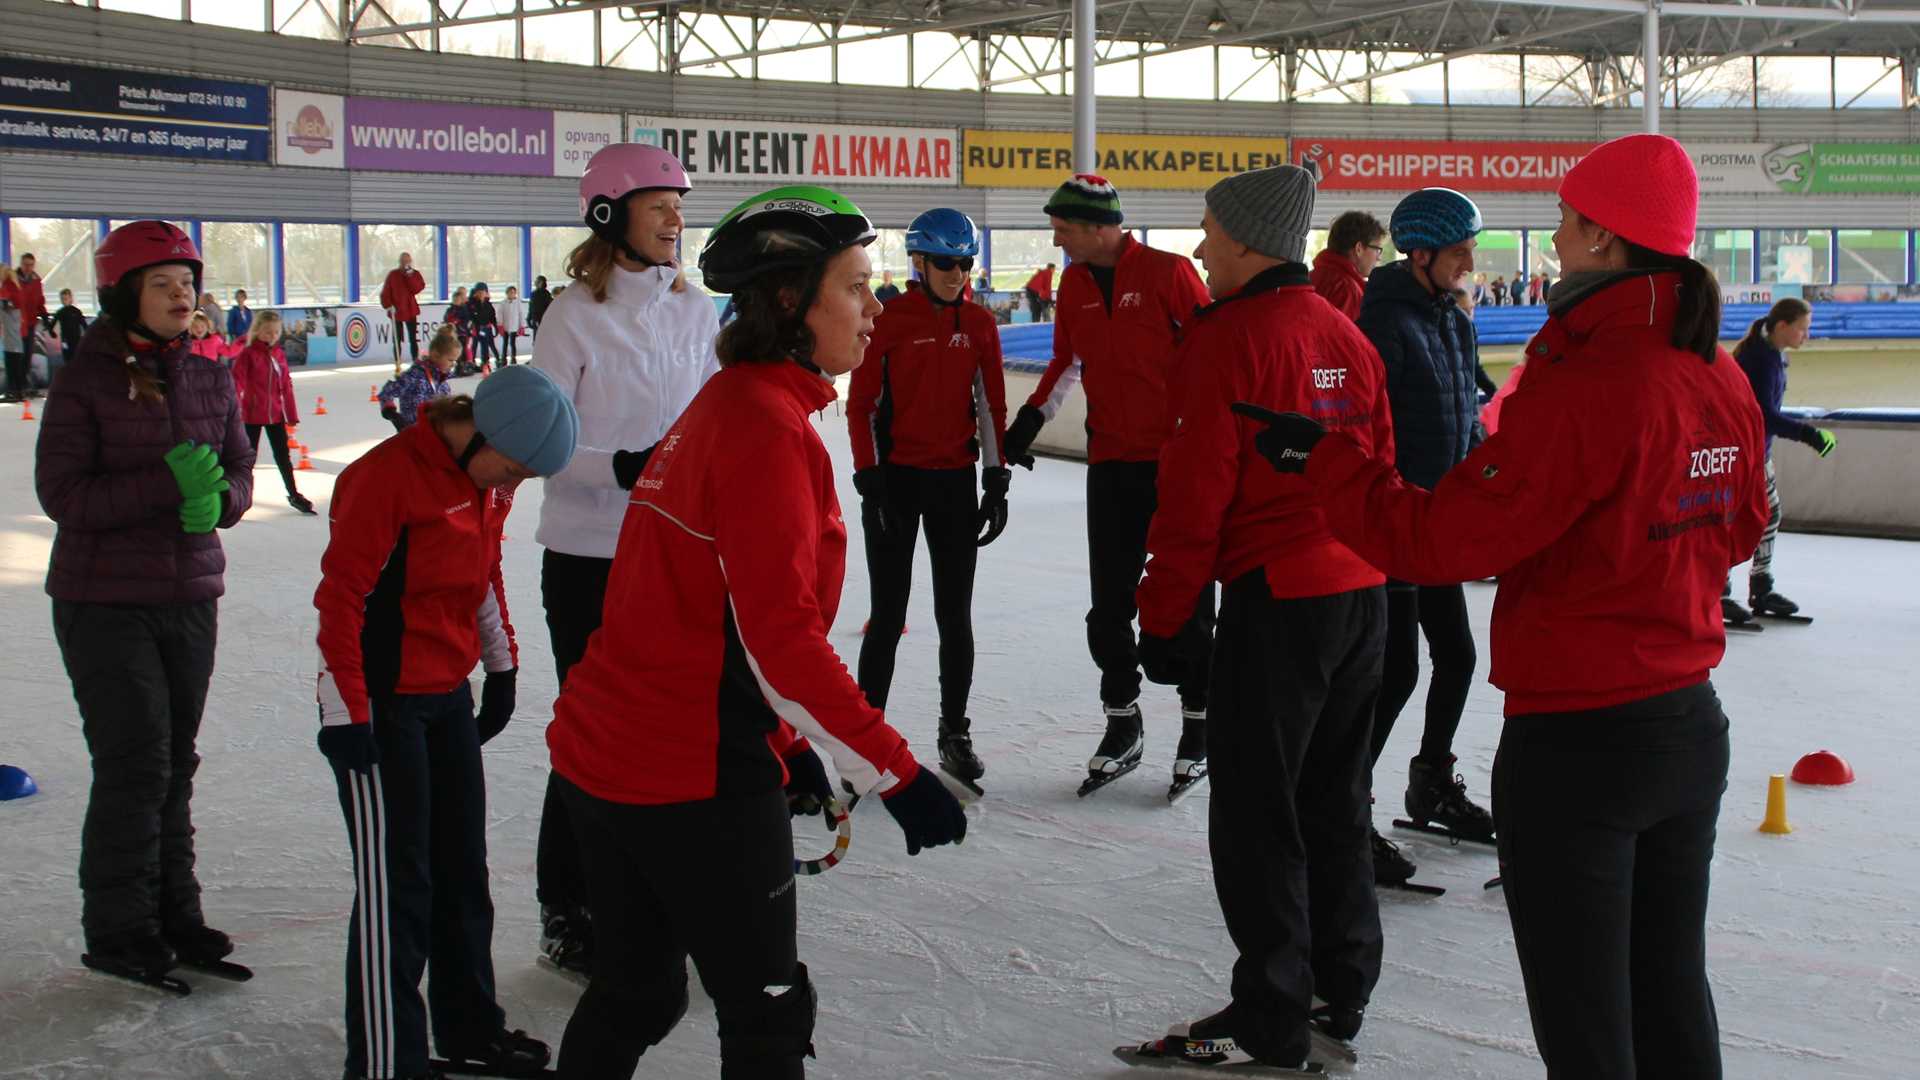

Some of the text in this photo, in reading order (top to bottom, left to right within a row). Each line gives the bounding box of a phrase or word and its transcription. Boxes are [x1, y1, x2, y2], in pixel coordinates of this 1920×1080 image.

[1, 76, 71, 92] www.pirtek.nl
[119, 84, 247, 109] Pirtek Alkmaar 072 541 00 90
[51, 125, 101, 143] service,
[102, 127, 129, 142] 24/7
[131, 132, 147, 143] en
[148, 130, 170, 146] 365
[171, 132, 206, 150] dagen
[207, 137, 226, 151] per
[226, 136, 248, 151] jaar
[350, 124, 547, 155] www.rollebol.nl
[565, 131, 610, 146] opvang
[563, 149, 579, 163] op
[661, 127, 951, 179] DE MEENT ALKMAAR
[968, 145, 1072, 170] RUITER
[1701, 154, 1756, 165] POSTMA
[1819, 153, 1898, 167] SCHAATSEN
[1339, 153, 1585, 179] SCHIPPER KOZIJN
[1311, 367, 1348, 389] ZOEFF
[1281, 448, 1310, 460] Roge
[1690, 446, 1740, 478] ZOEFF
[1185, 1043, 1240, 1055] SALOM
